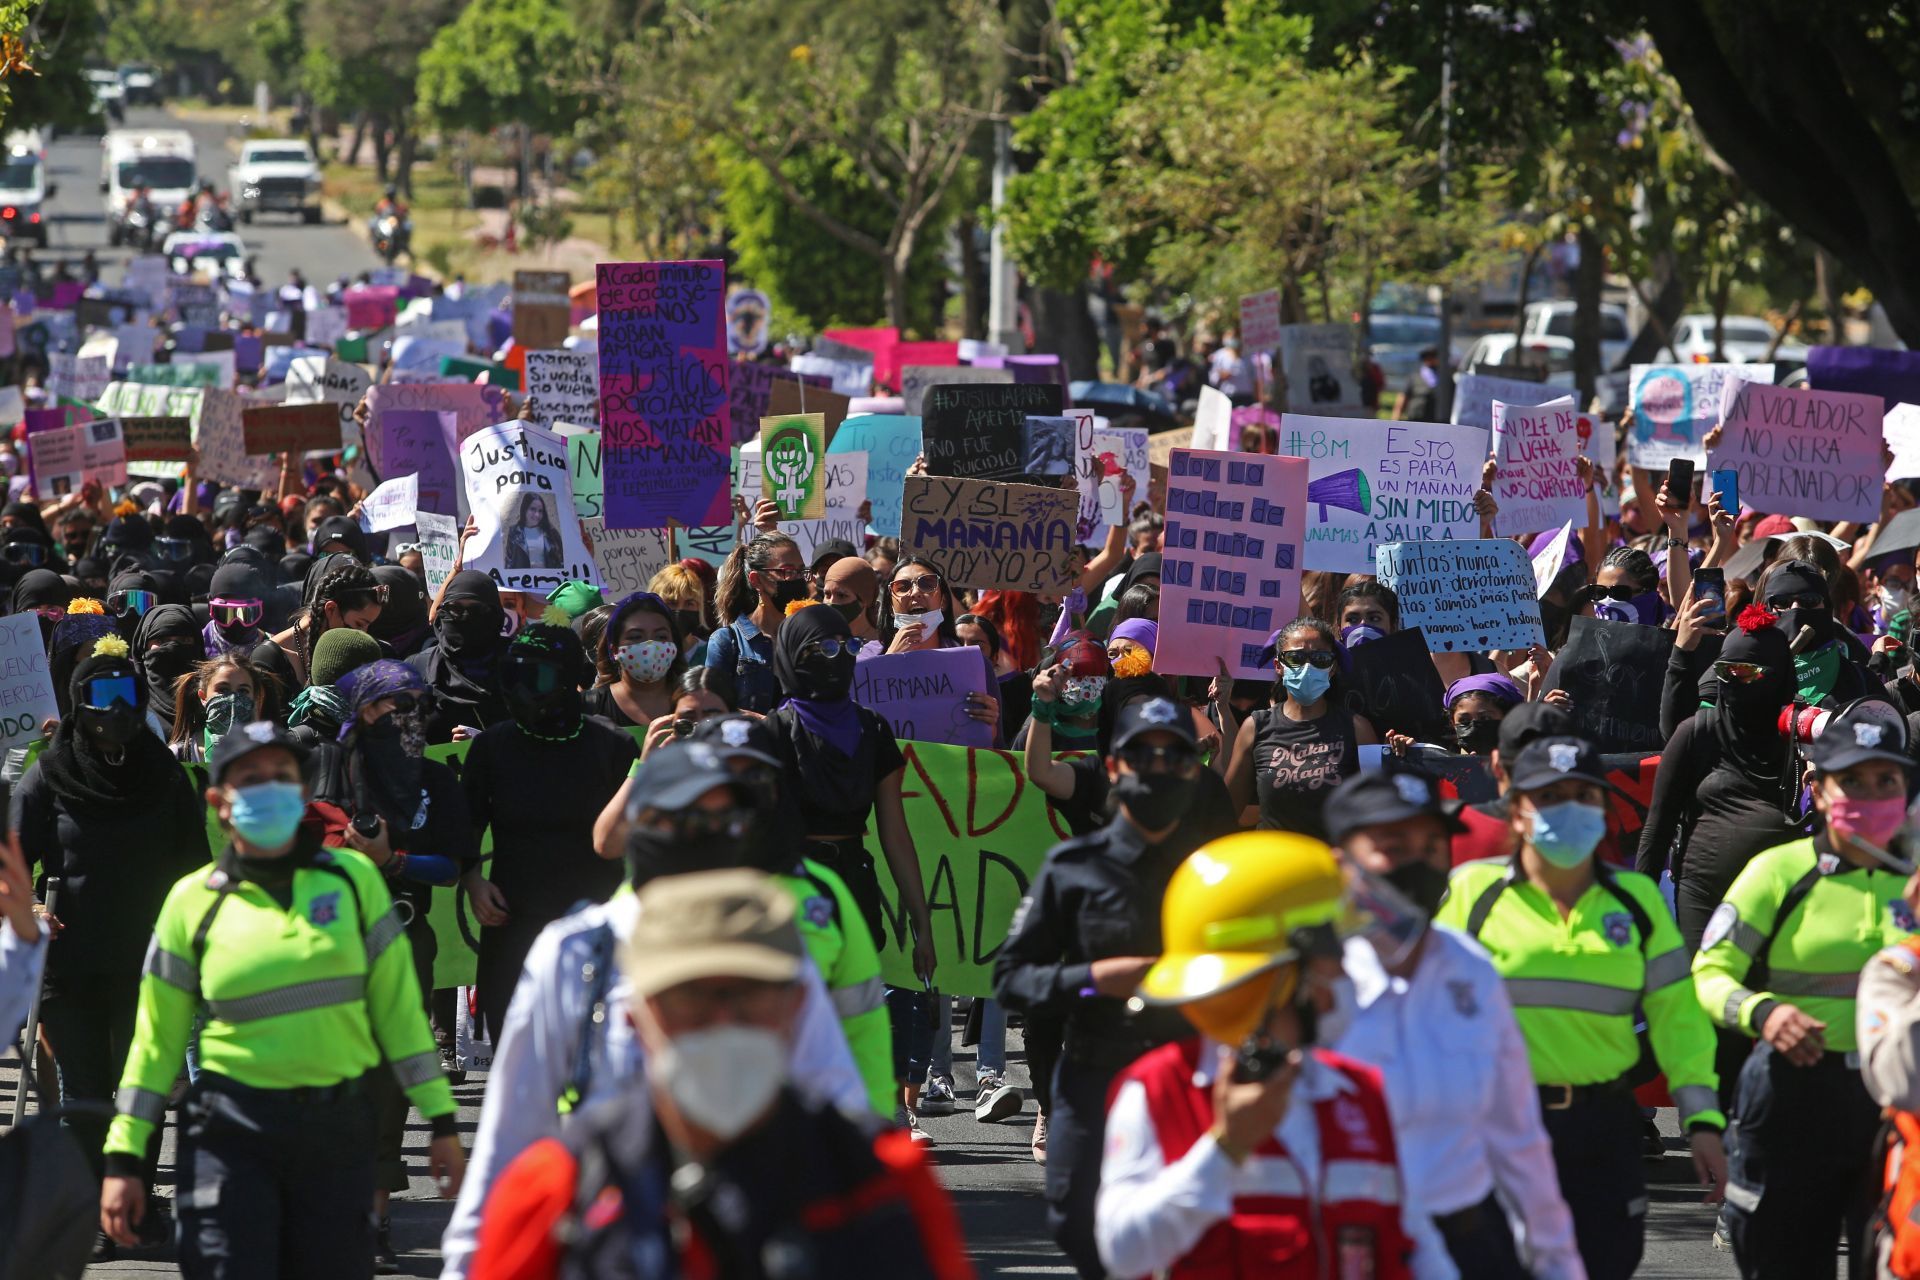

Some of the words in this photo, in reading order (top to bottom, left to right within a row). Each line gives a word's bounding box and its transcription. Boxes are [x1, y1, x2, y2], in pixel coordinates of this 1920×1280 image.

[1555, 410, 1574, 433] DE
[1761, 393, 1867, 436] VIOLADOR
[603, 420, 648, 443] NOS
[650, 418, 724, 443] MATAN
[1741, 427, 1774, 456] NO
[471, 431, 568, 473] Justicia
[603, 443, 722, 466] HERMANAS
[1505, 438, 1562, 463] LUCHA
[496, 469, 552, 495] para
[1379, 459, 1400, 474] ES
[1409, 459, 1458, 479] PARA
[1378, 480, 1399, 493] UN
[1405, 478, 1473, 496] MAÑANA
[1252, 498, 1284, 526] de
[1374, 494, 1409, 521] SIN
[1416, 499, 1476, 524] MIEDO
[913, 517, 1071, 552] MAÑANA
[1364, 522, 1378, 540] A
[1385, 522, 1434, 542] SALIR
[1384, 545, 1451, 578] Juntas
[1456, 554, 1500, 571] nunca
[1425, 623, 1465, 634] vamos
[852, 666, 954, 704] HERMANA
[1797, 666, 1821, 682] galYa
[1270, 740, 1345, 768] Making
[1272, 761, 1343, 790] Magic
